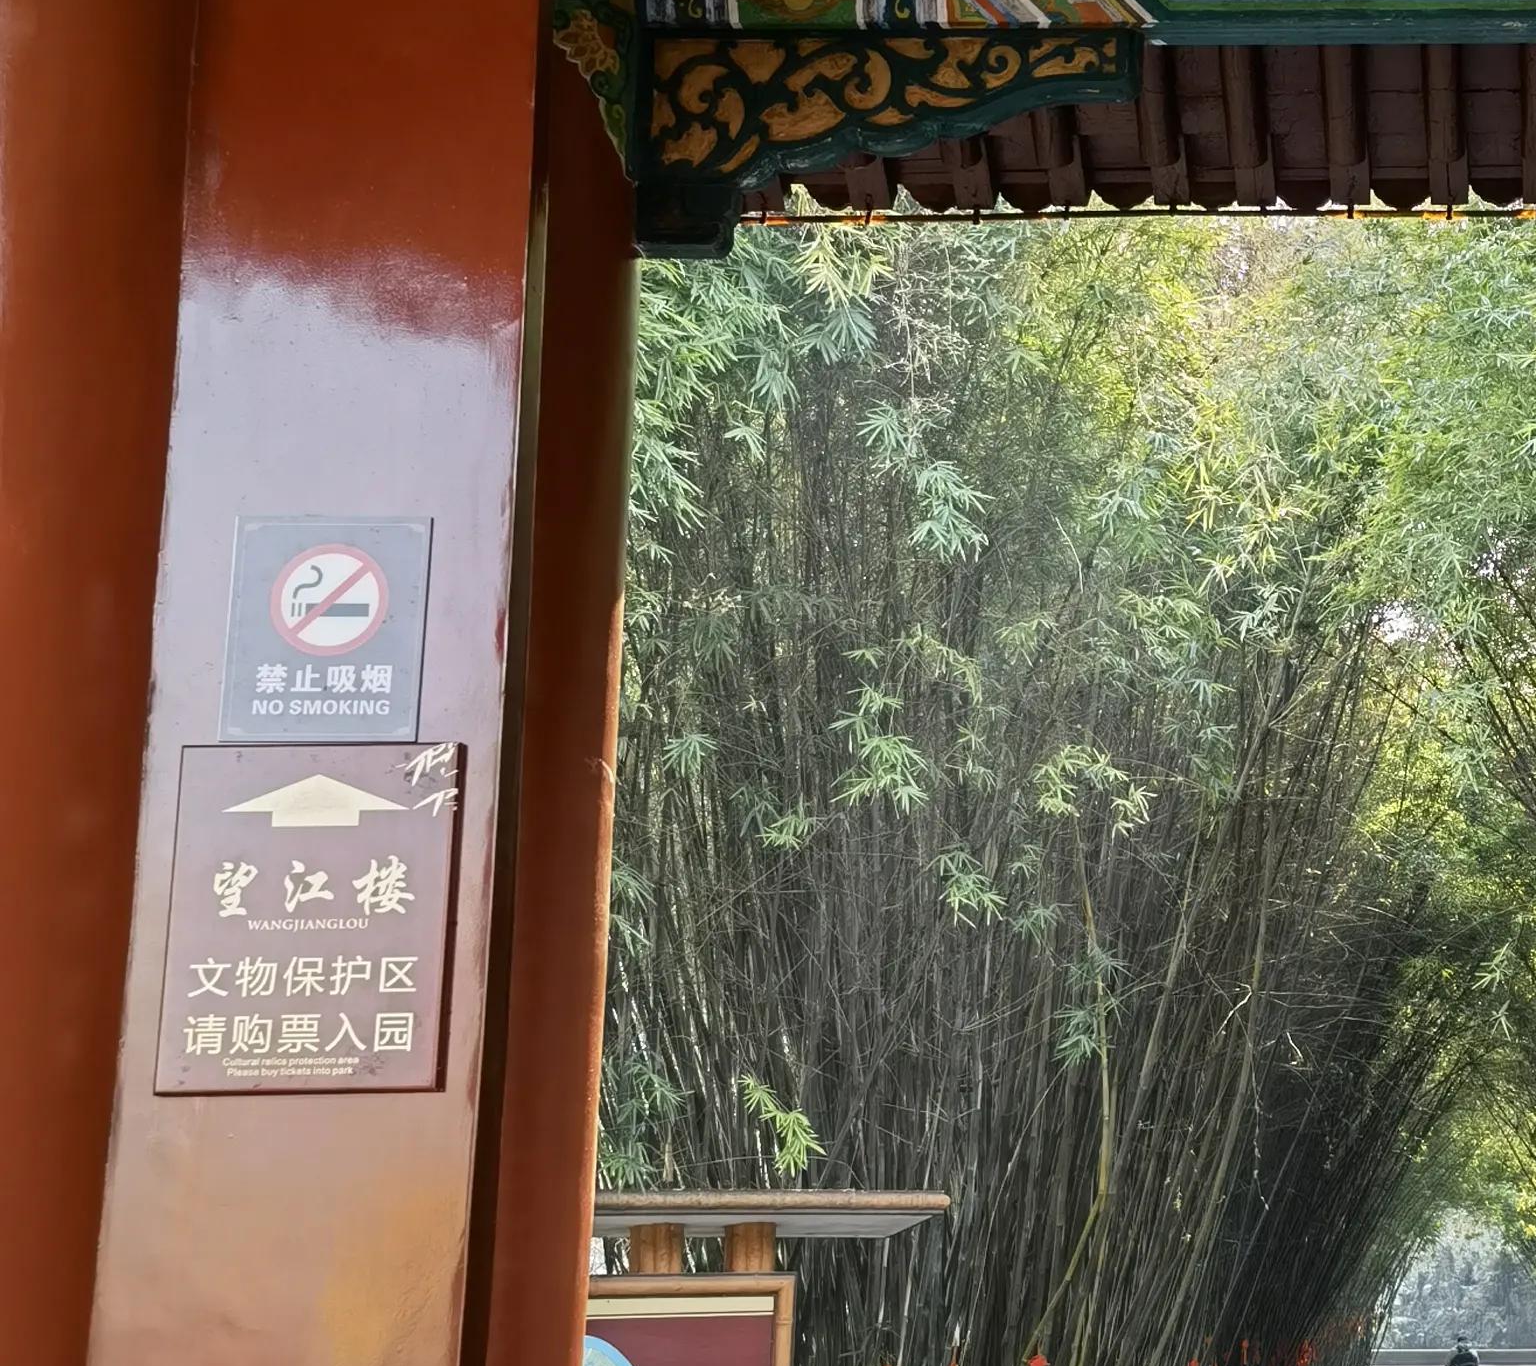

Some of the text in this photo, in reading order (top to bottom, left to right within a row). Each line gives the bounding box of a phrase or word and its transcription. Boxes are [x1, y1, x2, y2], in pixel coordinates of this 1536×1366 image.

[255, 663, 393, 694] 禁止吸烟
[251, 699, 391, 715] NO SMOKING
[213, 854, 416, 917] 望江楼
[247, 917, 370, 932] WANGJIANGLOU
[187, 954, 419, 998] 文物保护区
[183, 1012, 415, 1055] 请购票入园
[227, 1066, 354, 1078] Please buy tickets into park
[261, 1057, 287, 1066] relics
[288, 1056, 336, 1067] protection
[337, 1057, 360, 1065] area
